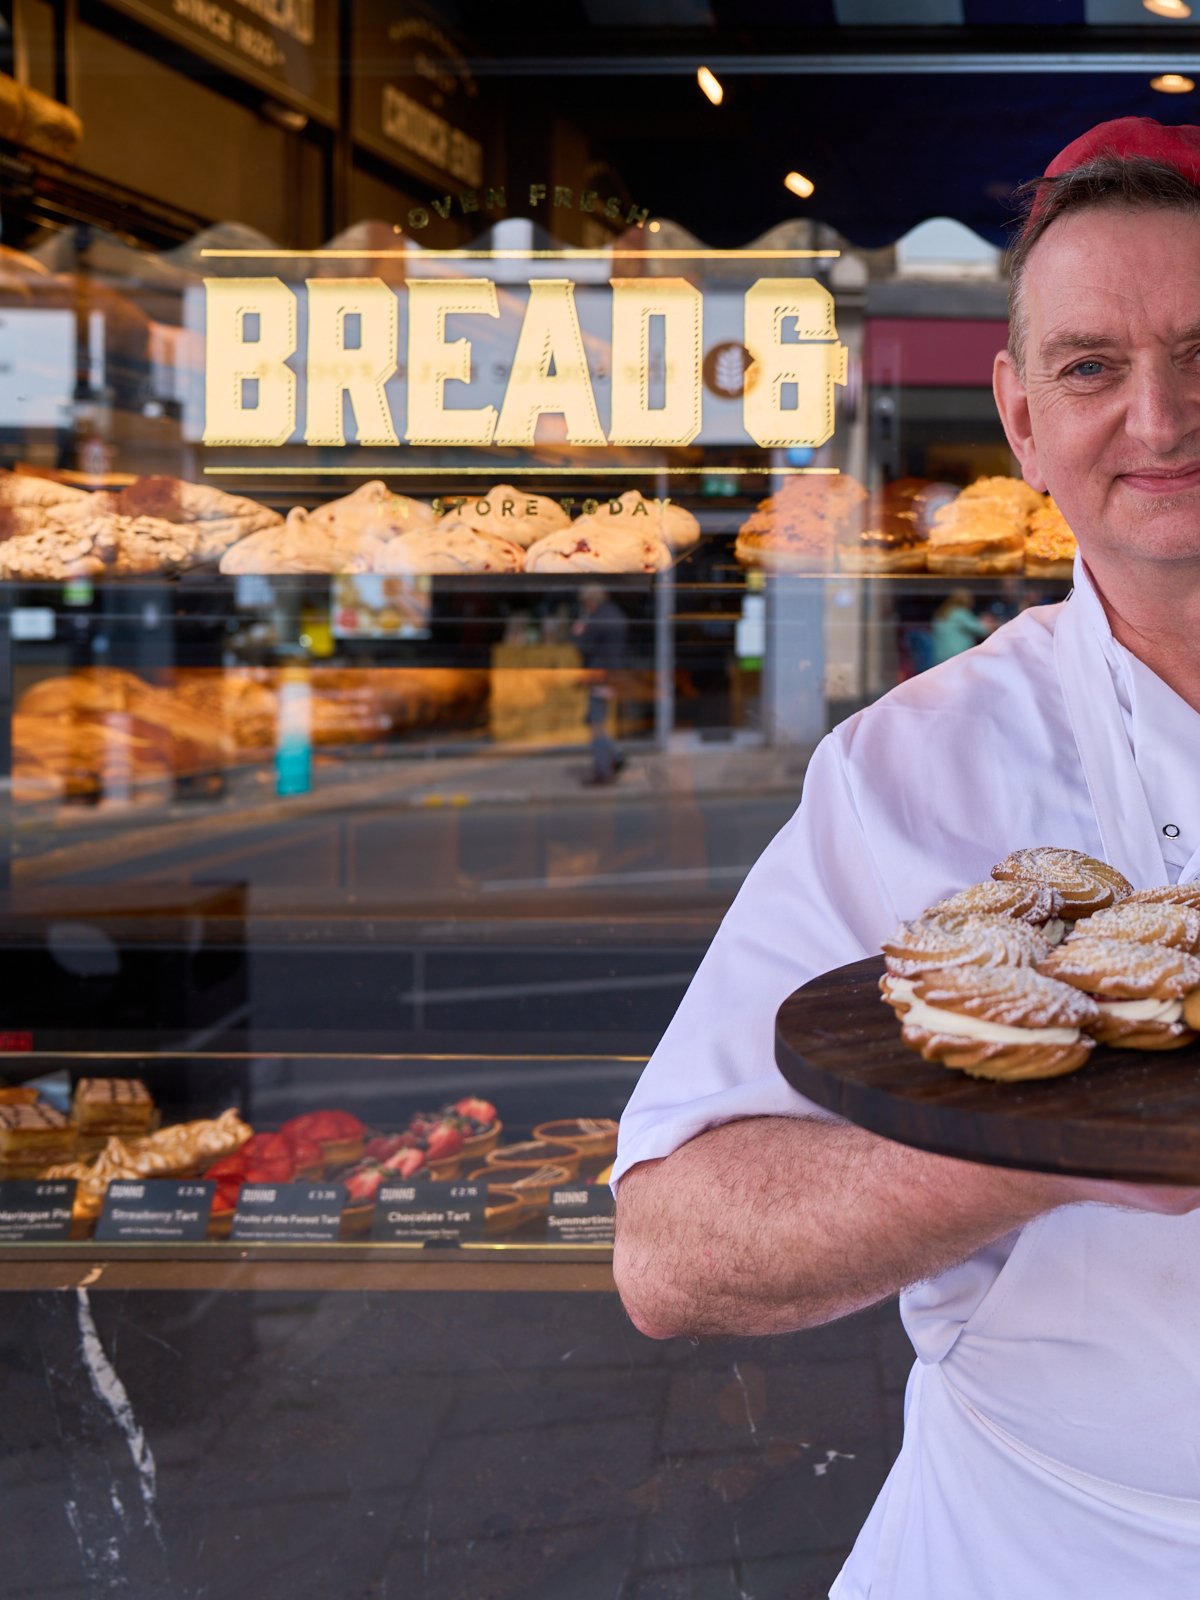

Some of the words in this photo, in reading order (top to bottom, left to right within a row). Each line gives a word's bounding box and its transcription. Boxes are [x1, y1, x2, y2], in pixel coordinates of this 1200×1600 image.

[407, 186, 507, 230] OVEN
[529, 184, 650, 229] FRESH
[202, 277, 703, 447] BREAD
[743, 277, 849, 448] &
[431, 498, 538, 516] STORE
[560, 498, 672, 517] TODAY
[175, 1209, 200, 1221] Tart
[273, 1214, 289, 1224] the
[387, 1210, 445, 1223] Chocolate
[446, 1210, 472, 1222] Tart
